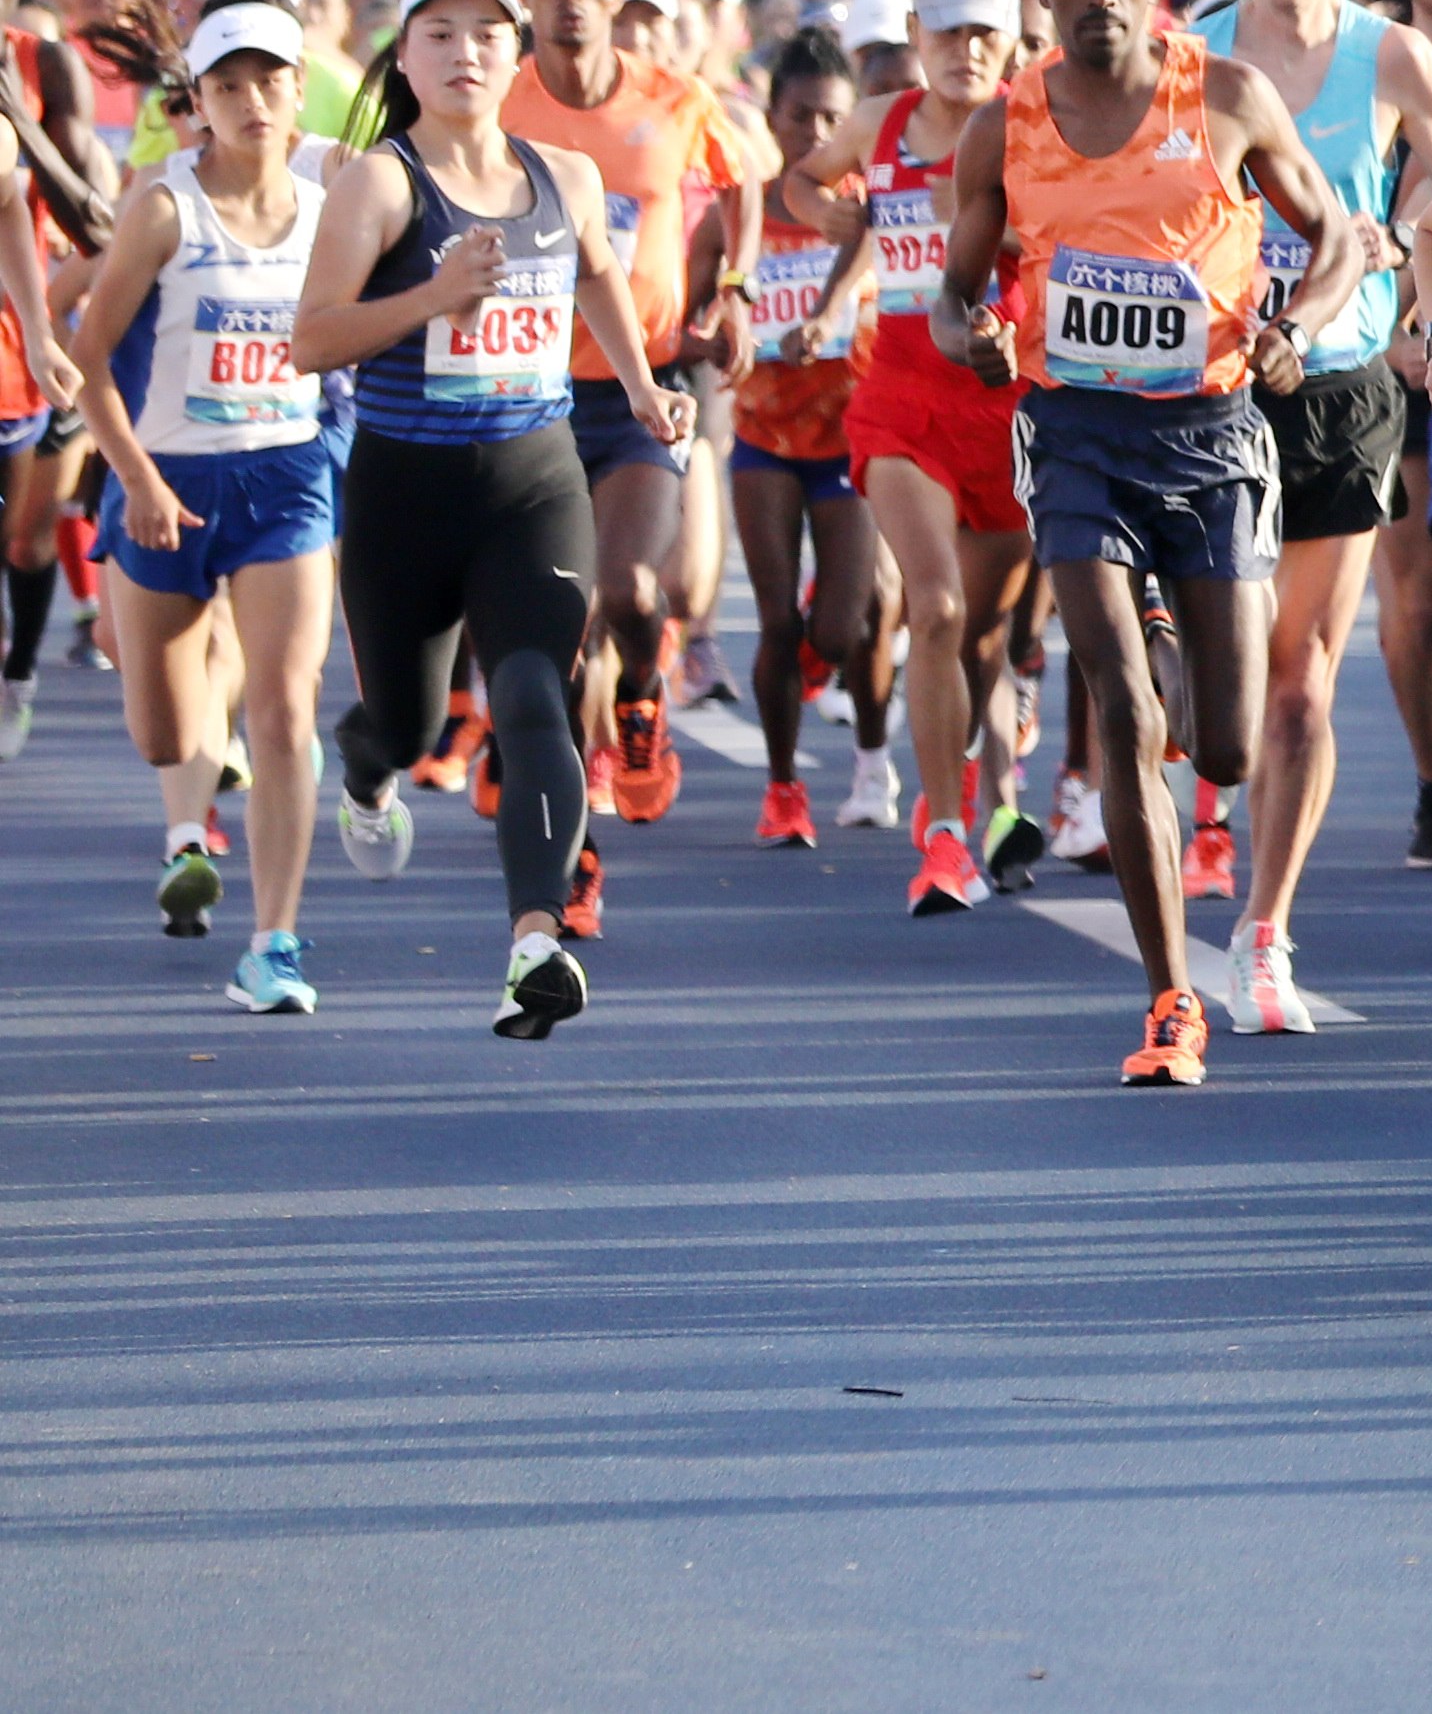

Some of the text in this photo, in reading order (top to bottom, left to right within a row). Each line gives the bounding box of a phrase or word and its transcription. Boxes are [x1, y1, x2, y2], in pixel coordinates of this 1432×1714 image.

[1071, 263, 1181, 297] 六个核桃
[1060, 295, 1187, 350] A009
